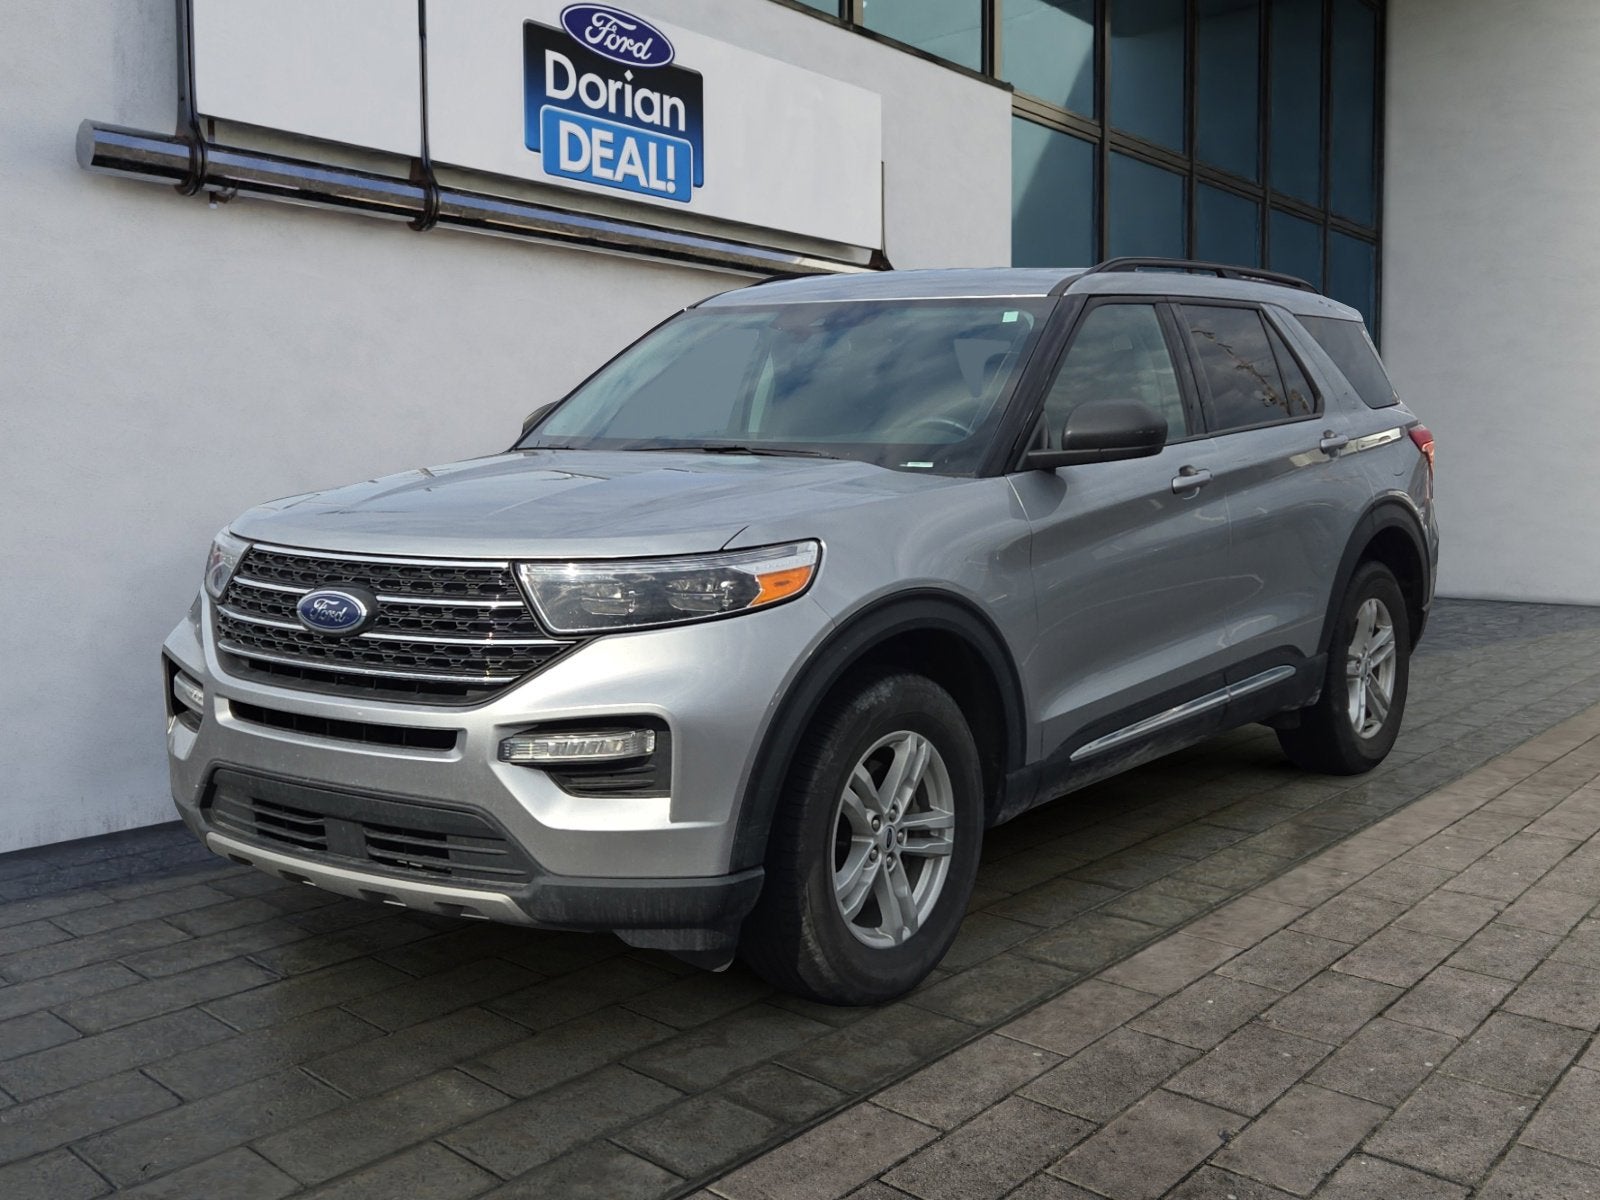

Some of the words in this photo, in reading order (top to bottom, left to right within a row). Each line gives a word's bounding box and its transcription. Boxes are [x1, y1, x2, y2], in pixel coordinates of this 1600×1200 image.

[585, 12, 652, 60] Ford
[545, 49, 686, 132] Dorian
[559, 120, 676, 194] DEAL!
[310, 598, 348, 623] Ford
